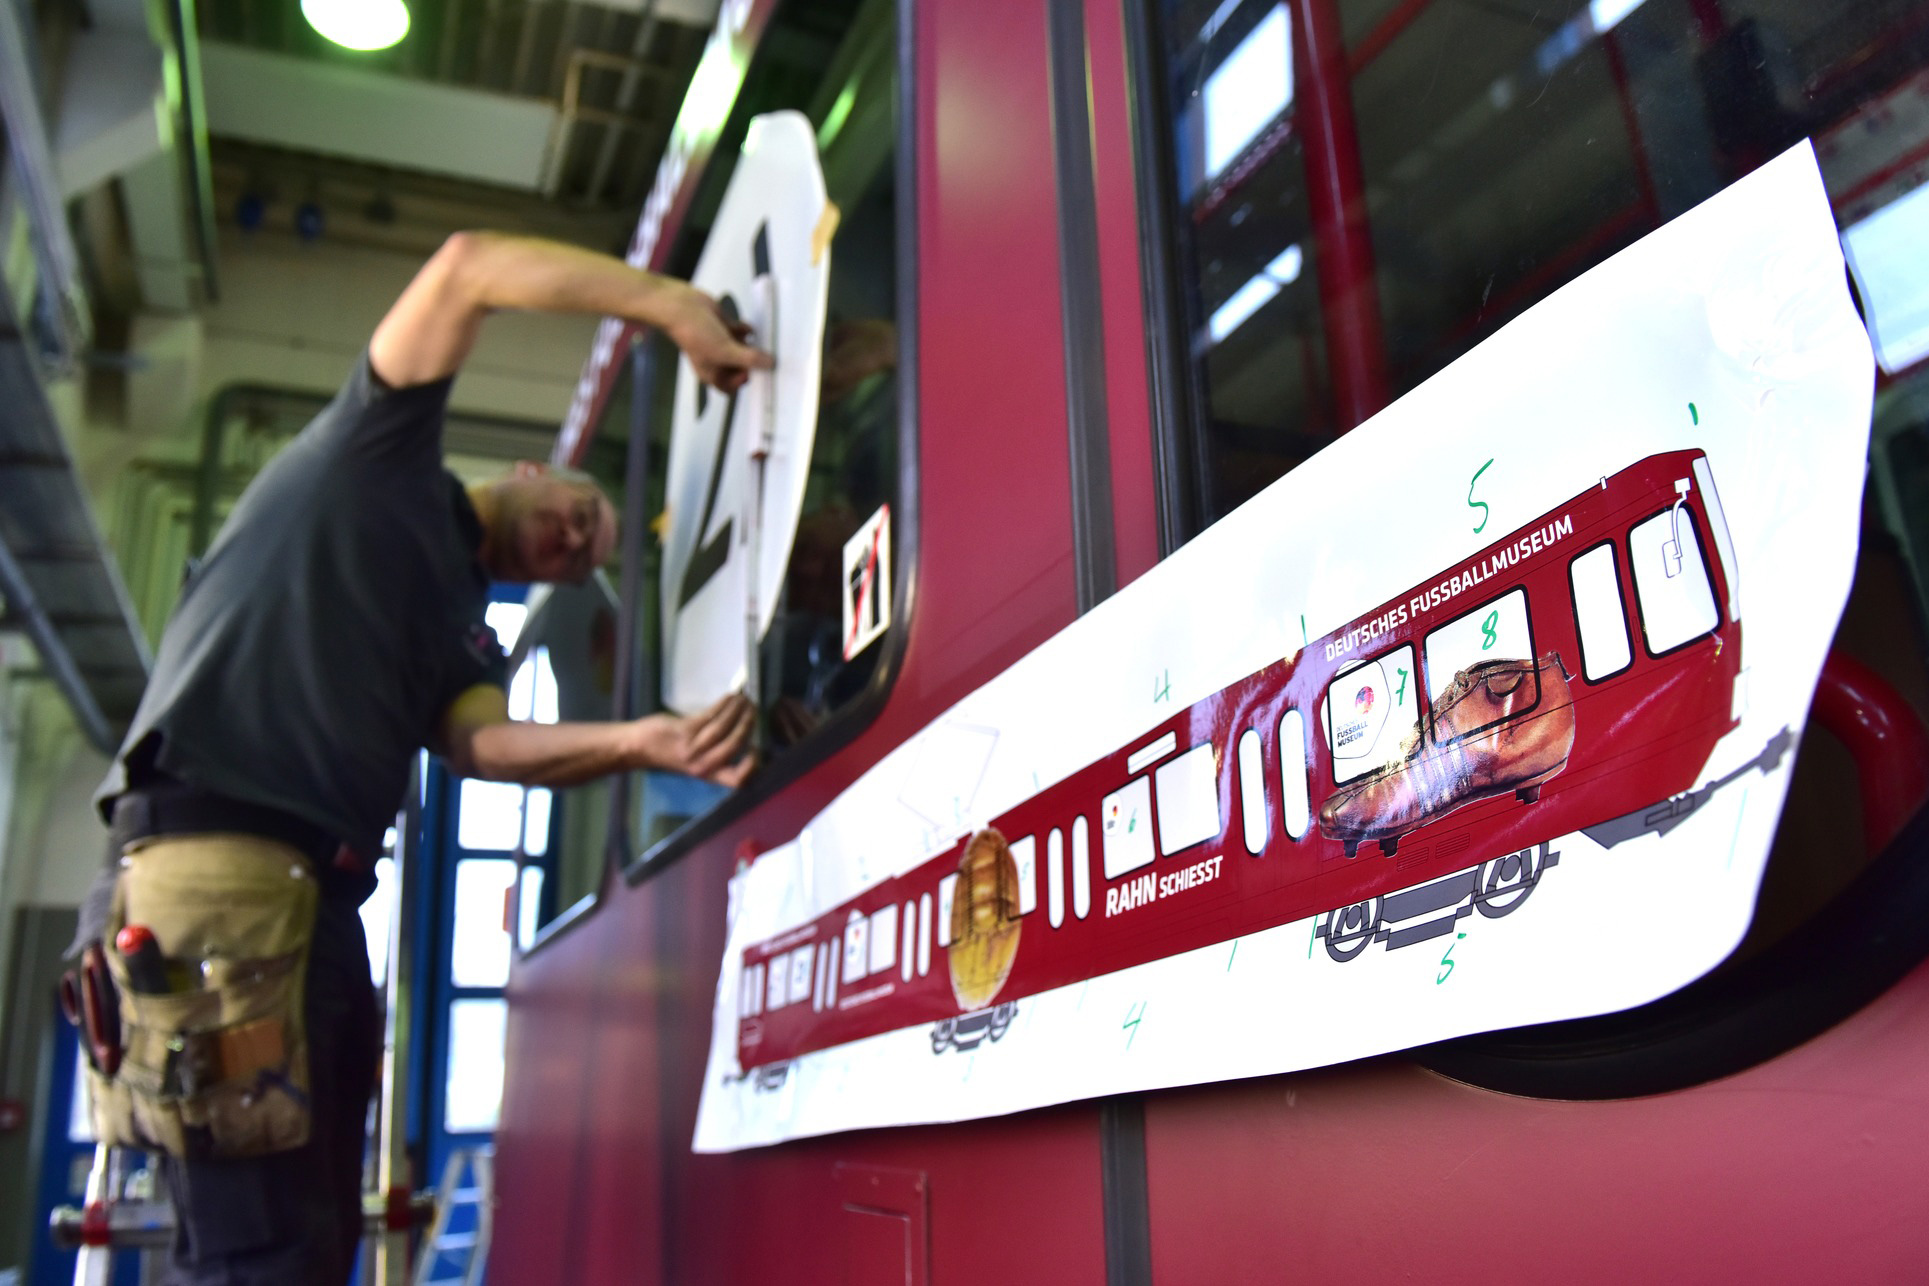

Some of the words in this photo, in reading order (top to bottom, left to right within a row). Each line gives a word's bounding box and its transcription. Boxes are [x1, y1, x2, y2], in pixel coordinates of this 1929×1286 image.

[1468, 458, 1494, 534] 5
[1325, 605, 1407, 661] DEUTSCHES
[1410, 514, 1573, 617] FUSSBALLMUSEUM
[1481, 610, 1499, 650] 8
[1154, 669, 1172, 703] 4
[1395, 668, 1408, 707] 7
[1337, 721, 1368, 740] FUSSBALL
[1337, 731, 1364, 748] MUSEUM
[1105, 871, 1157, 918] RAHN
[1159, 855, 1223, 898] SCHIESST
[1436, 932, 1467, 986] 5
[1122, 1002, 1147, 1051] 4
